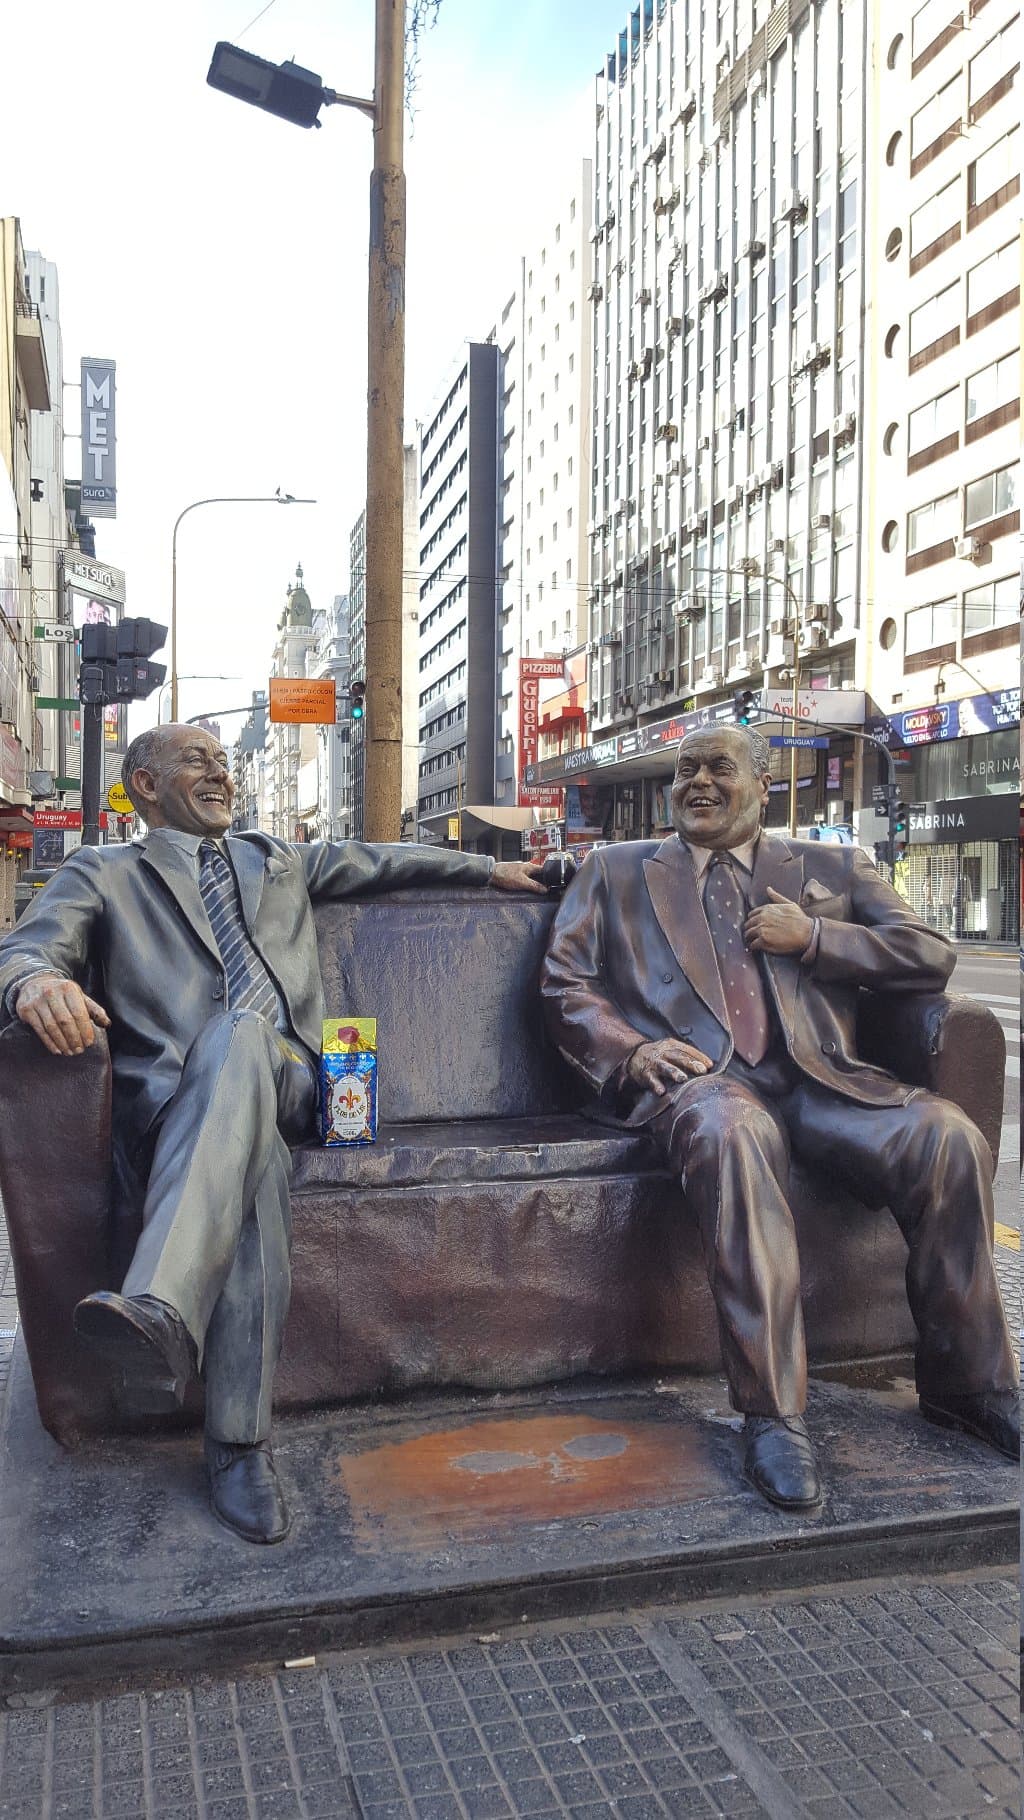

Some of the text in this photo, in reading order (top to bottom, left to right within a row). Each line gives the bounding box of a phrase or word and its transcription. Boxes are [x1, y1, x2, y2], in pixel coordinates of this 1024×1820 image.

[86, 372, 110, 480] MET
[83, 488, 105, 497] sura
[74, 564, 89, 578] MET
[523, 663, 563, 674] PIZZERIA
[522, 679, 538, 767] Güerri
[783, 738, 815, 746] URUGUAY
[963, 757, 1020, 777] SABRINA
[112, 792, 128, 800] Sub
[36, 813, 68, 822] Uruguay
[909, 812, 965, 830] SABRINA
